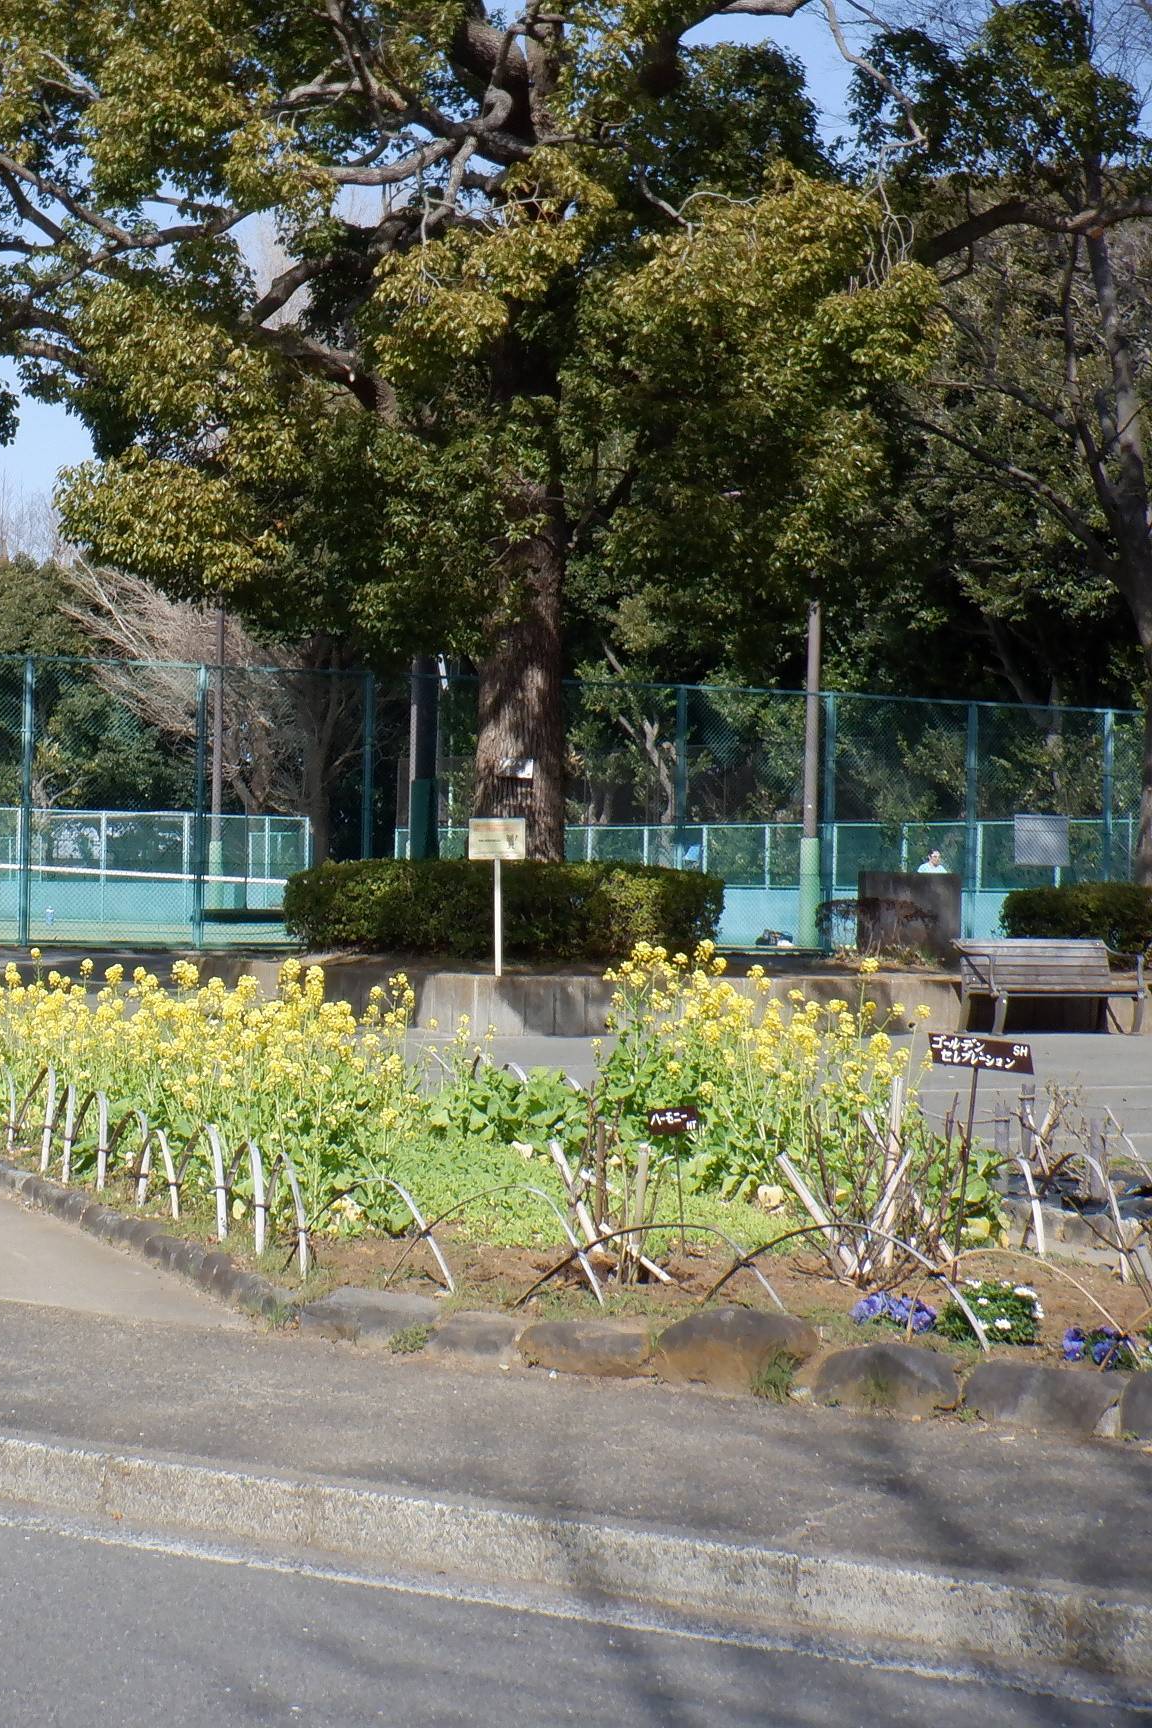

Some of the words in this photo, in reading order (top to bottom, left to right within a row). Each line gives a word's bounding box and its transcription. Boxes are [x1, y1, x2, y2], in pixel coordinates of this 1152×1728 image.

[931, 1035, 986, 1053] ゴールデン
[1012, 1045, 1029, 1057] SH
[940, 1048, 1016, 1069] セレブレーション
[650, 1111, 688, 1126] ハーモニー
